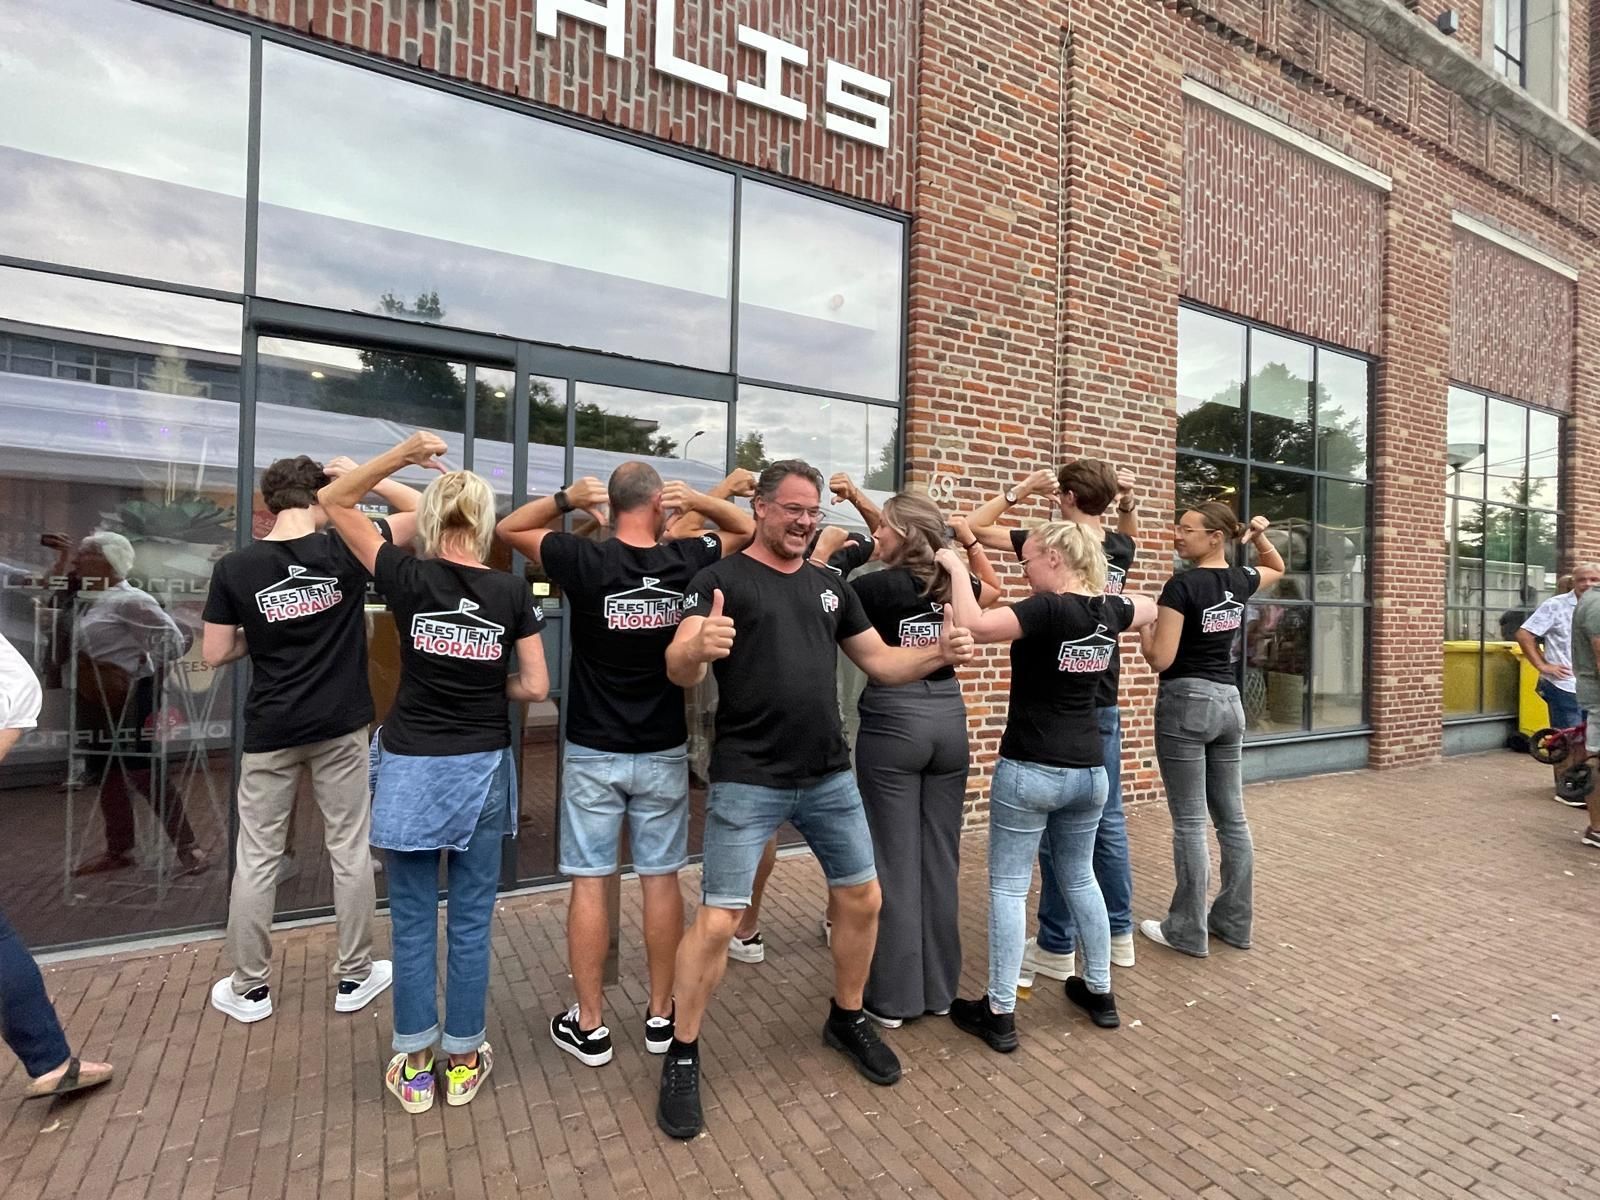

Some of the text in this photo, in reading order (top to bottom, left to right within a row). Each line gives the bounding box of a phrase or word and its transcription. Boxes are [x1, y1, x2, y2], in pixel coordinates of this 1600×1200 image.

[81, 576, 211, 593] FLORAL
[266, 591, 343, 622] FLORALIS
[414, 635, 503, 660] FLORALIS
